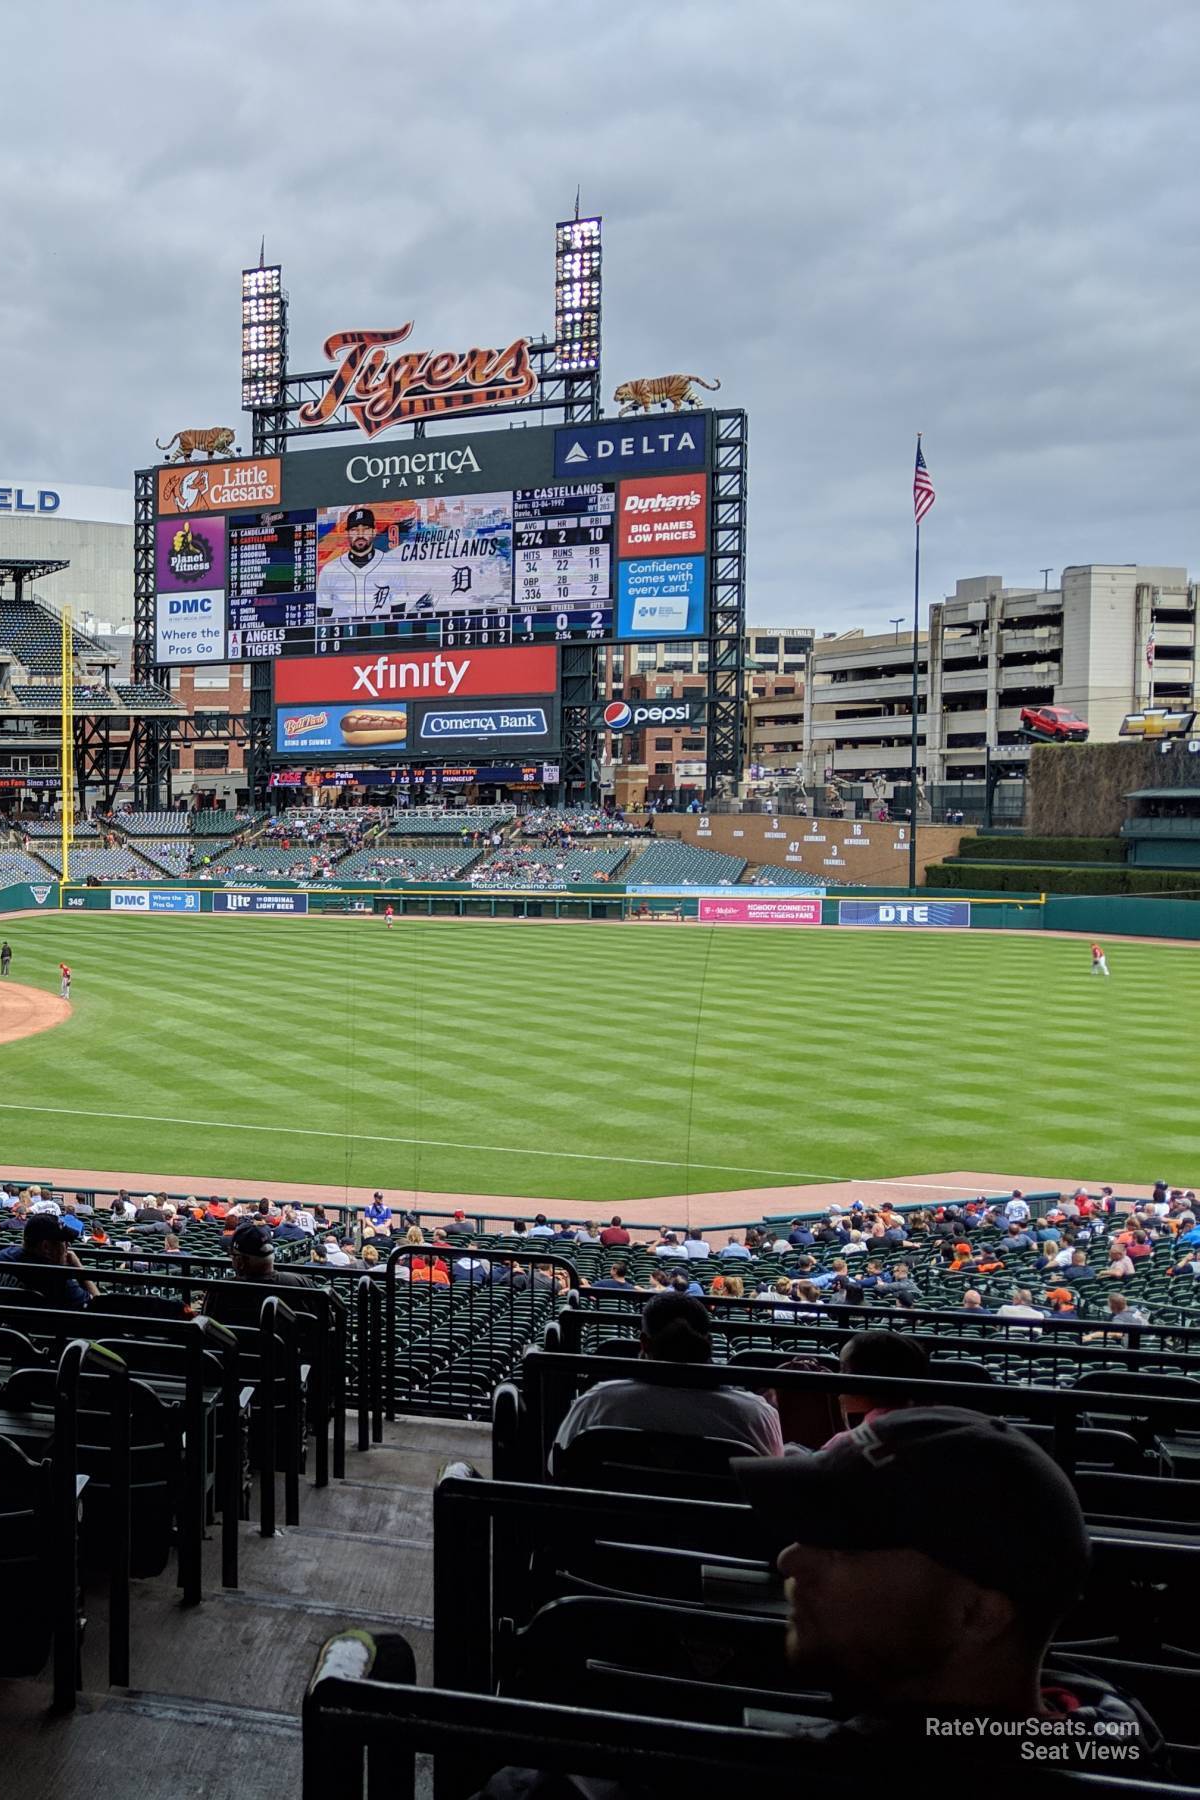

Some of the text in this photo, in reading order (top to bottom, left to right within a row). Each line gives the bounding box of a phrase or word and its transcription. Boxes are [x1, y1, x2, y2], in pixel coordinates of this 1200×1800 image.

[299, 320, 538, 440] Tigers
[597, 432, 695, 458] DELTA
[223, 466, 268, 487] Little
[382, 473, 444, 488] PARK
[210, 484, 274, 504] Caesars
[516, 483, 604, 500] 9 CASTELLANOS
[624, 490, 701, 512] Dunham's
[524, 522, 537, 530] AVG
[590, 517, 602, 525] RBI
[631, 521, 693, 533] BIG NAMES
[388, 525, 399, 549] 9
[415, 529, 461, 544] NICHOLAS
[517, 527, 603, 546] .274 2 10
[628, 531, 696, 544] LOW PRICES
[401, 538, 498, 562] CASTELLANOS
[523, 547, 600, 560] HITS RUNS BB
[171, 553, 204, 566] planet
[526, 558, 600, 573] 34 22 11
[175, 561, 210, 572] fitness
[628, 561, 693, 574] Confidence
[524, 574, 599, 586] OBP 2B 3B
[628, 571, 693, 585] comes with
[522, 585, 598, 600] .336 10 2
[628, 586, 660, 597] every
[169, 598, 212, 614] DMC
[523, 612, 603, 632] 1 0 2
[161, 628, 220, 640] Where the
[246, 617, 505, 643] ANGELS 2 3 1 6 7 0 0
[529, 633, 534, 641] 3
[555, 631, 572, 640] 2:54
[169, 643, 212, 655] Pros Go
[246, 631, 505, 657] TIGERS 0 0 0 2 0 2
[352, 654, 471, 697] xfinity
[499, 712, 537, 729] Bank
[634, 704, 690, 724] pepsi
[11, 779, 25, 787] Fans
[699, 818, 709, 828] 23
[773, 819, 778, 829] 5
[812, 822, 818, 832] 2
[853, 825, 862, 835] 16
[899, 829, 905, 839] 6
[789, 842, 800, 852] 47
[832, 845, 838, 856] 3
[471, 882, 567, 890] MotorCityCasino.com
[115, 895, 146, 905] DMC
[227, 894, 251, 910] Lite
[263, 896, 294, 904] ORIGINAL
[879, 905, 928, 922] DTE
